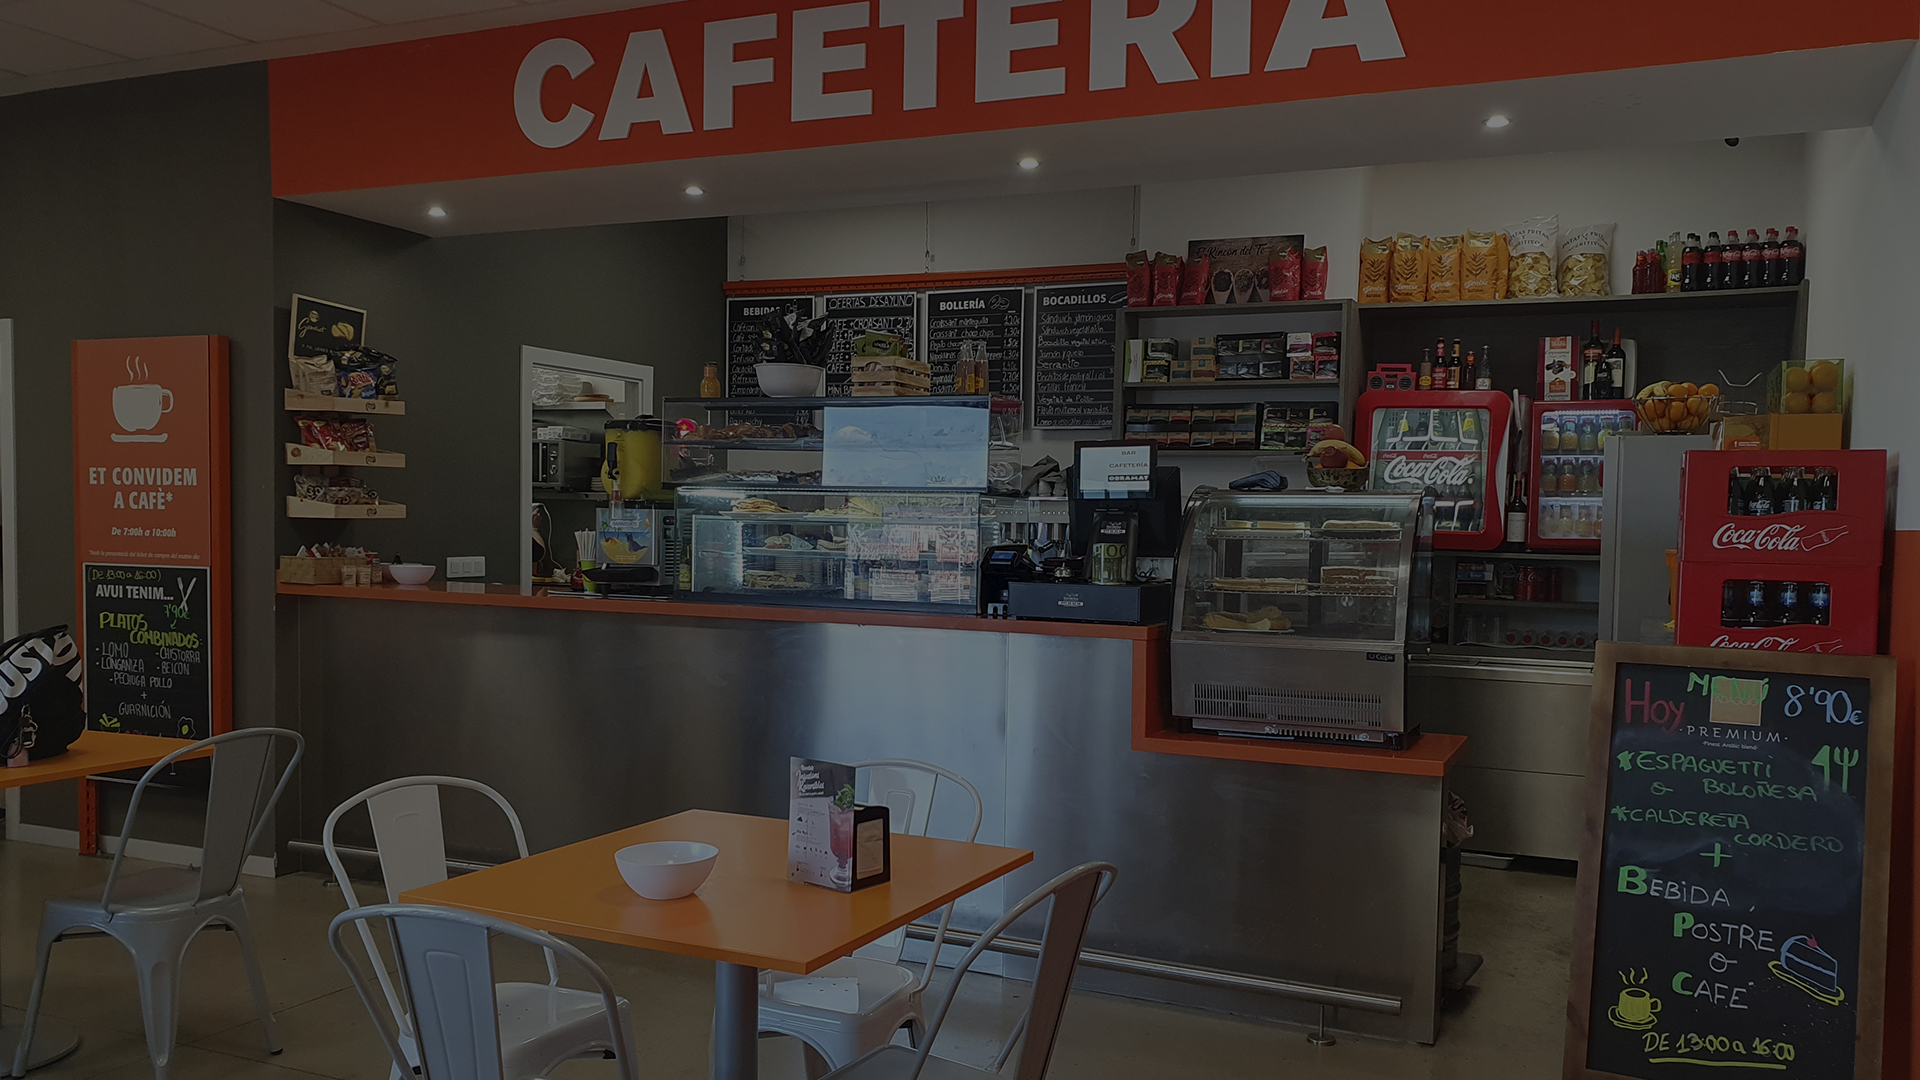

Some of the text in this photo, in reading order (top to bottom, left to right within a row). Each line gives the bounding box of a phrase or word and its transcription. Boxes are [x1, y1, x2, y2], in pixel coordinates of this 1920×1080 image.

[829, 295, 914, 309] OFERTAS DESAYUNO
[940, 298, 986, 311] BOLLERÍA
[1043, 294, 1106, 306] BOCADILLOS
[826, 363, 845, 373] CAFE
[89, 467, 197, 486] ET CONVIDEM
[114, 491, 124, 509] A
[112, 526, 121, 536] De
[123, 527, 143, 536] 7:00h
[152, 528, 177, 538] 10:00h
[1712, 522, 1806, 550] Coca-Cola
[96, 584, 174, 600] AVUI TENIM...
[100, 611, 148, 632] PLATOS
[102, 642, 129, 658] LOMO
[160, 647, 200, 664] CHISTORRA
[101, 658, 144, 673] LONGANIZA
[161, 663, 190, 675] BEICON
[114, 672, 173, 689] PECHUGA POLLO
[1687, 672, 1770, 703] MENÚ
[118, 700, 172, 719] GUARNICIÓN
[1625, 678, 1685, 733] Hoy
[1784, 684, 1864, 726] 8'90€
[1702, 778, 1817, 802] BOLOÑESA
[1630, 808, 1750, 829] CALDERETA
[1734, 831, 1844, 852] CORDERO
[1673, 912, 1775, 952] POSTRE
[1642, 1032, 1670, 1053] DE
